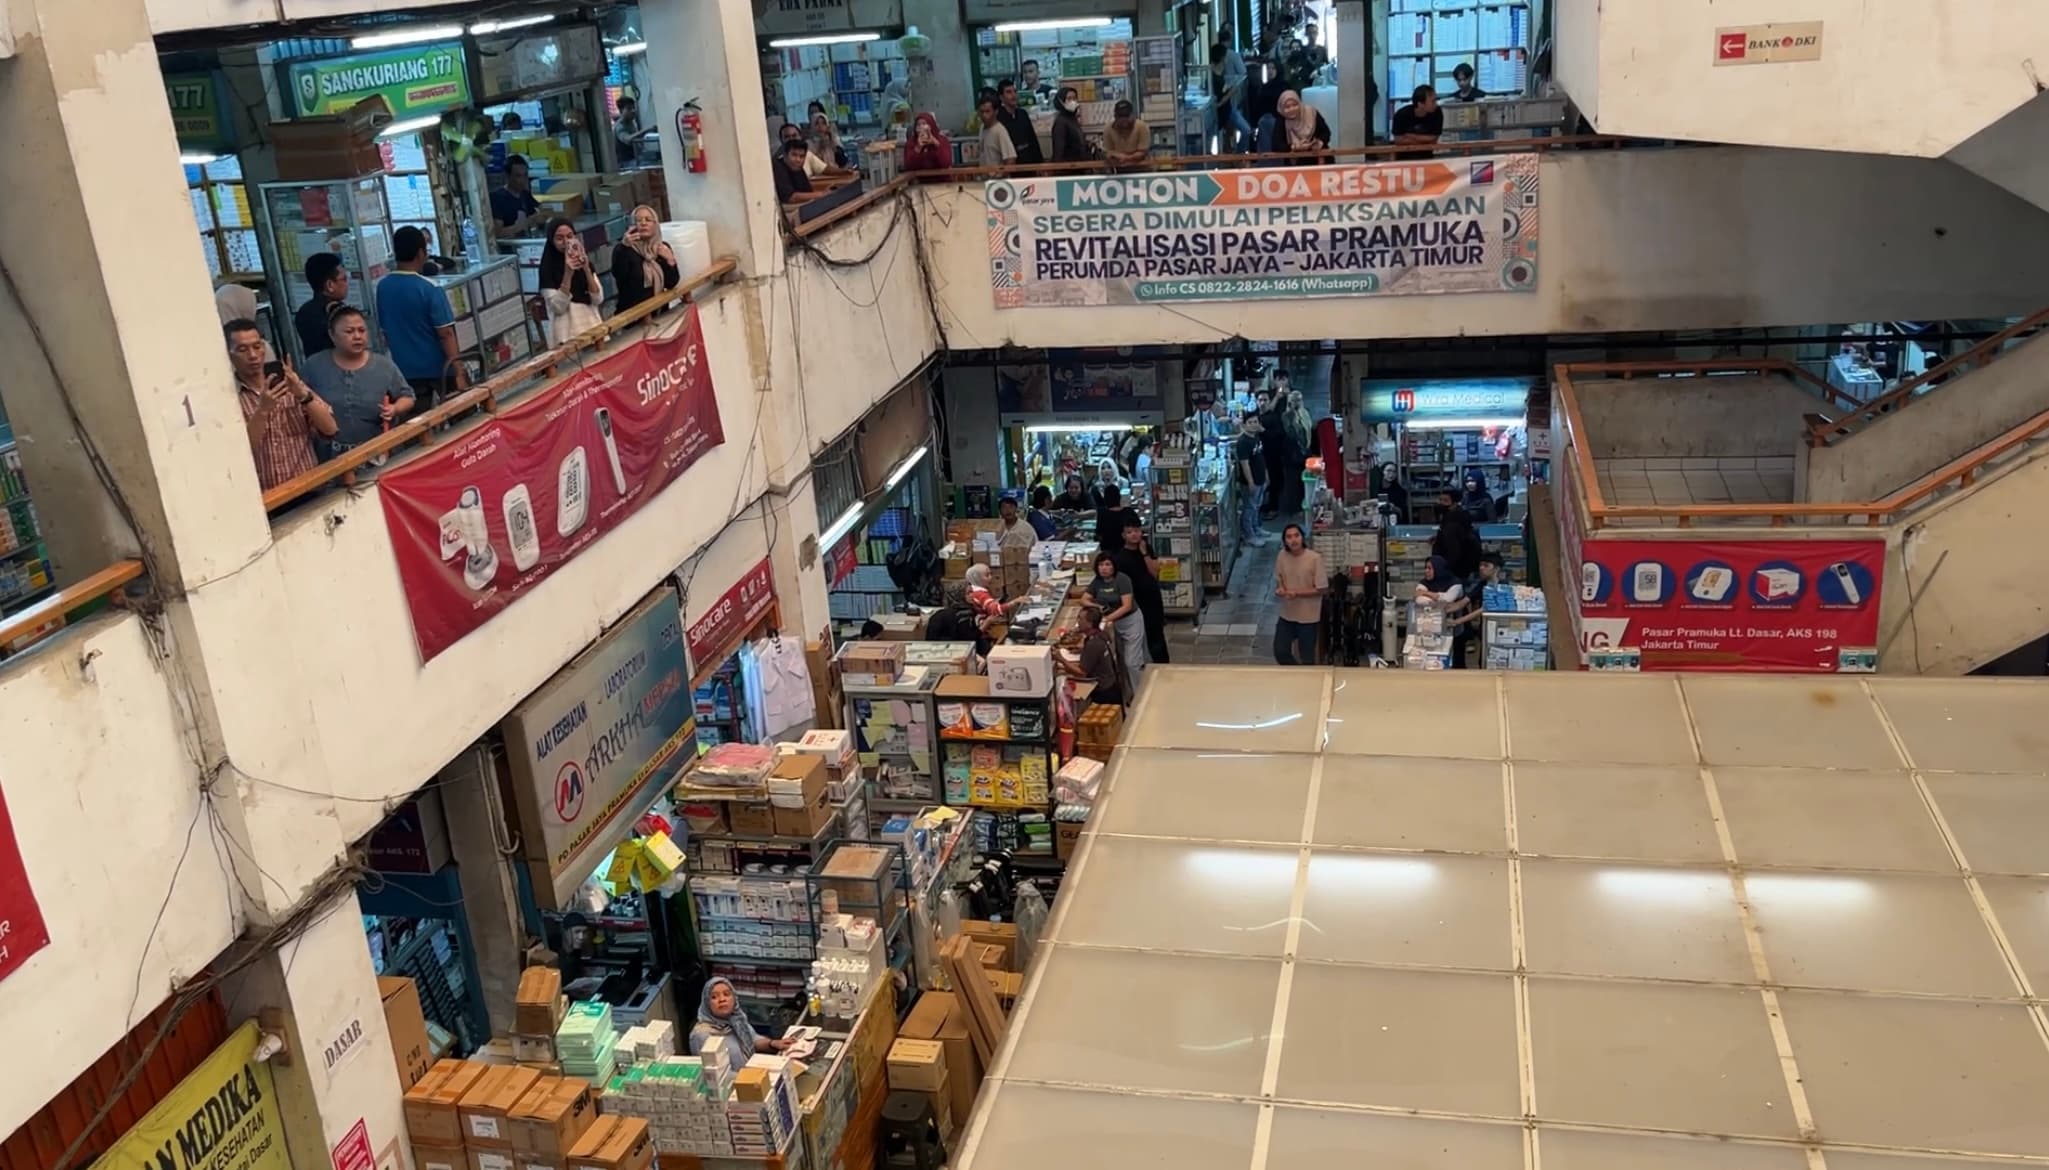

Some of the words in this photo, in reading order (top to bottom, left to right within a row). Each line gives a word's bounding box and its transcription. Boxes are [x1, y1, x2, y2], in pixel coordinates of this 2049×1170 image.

[1748, 39, 1780, 50] BANK
[1795, 36, 1817, 47] DKI
[321, 57, 428, 96] SANGKURIANG
[431, 55, 453, 76] 177
[1072, 176, 1198, 207] MOHON
[1237, 172, 1312, 200] DOA
[1321, 167, 1425, 197] RESTU
[1033, 213, 1137, 235] SEGERA
[1144, 207, 1260, 230] DIMULAI
[1268, 196, 1486, 226] PELAKSANAAN
[1035, 233, 1216, 261] REVITALISASI
[1221, 229, 1320, 256] PASAR
[1330, 220, 1485, 250] PRAMUKA
[1037, 259, 1141, 280] PERUMDA
[1144, 258, 1216, 277] PASAR
[1220, 255, 1280, 274] JAYA
[1299, 249, 1407, 271] JAKARTA
[1413, 246, 1483, 267] TIMUR
[1154, 283, 1178, 295] Info
[1180, 283, 1197, 294] CS
[1199, 279, 1299, 294] 0822-2824-1616
[1301, 276, 1373, 291] (Whatsapp)
[1453, 392, 1504, 405] Medical
[690, 598, 732, 647] Sinocare
[1641, 627, 1673, 638] Pasar
[1676, 627, 1726, 638] Pramuka
[1747, 628, 1784, 640] Dasar,
[1787, 628, 1812, 638] AKS
[1816, 629, 1838, 639] 198
[1641, 640, 1684, 650] Jakarta
[1686, 640, 1719, 650] Timur
[585, 702, 648, 784] ARKHA
[324, 1018, 363, 1069] DASAR
[175, 1063, 262, 1170] MEDIKA
[250, 1133, 273, 1165] Dasar
